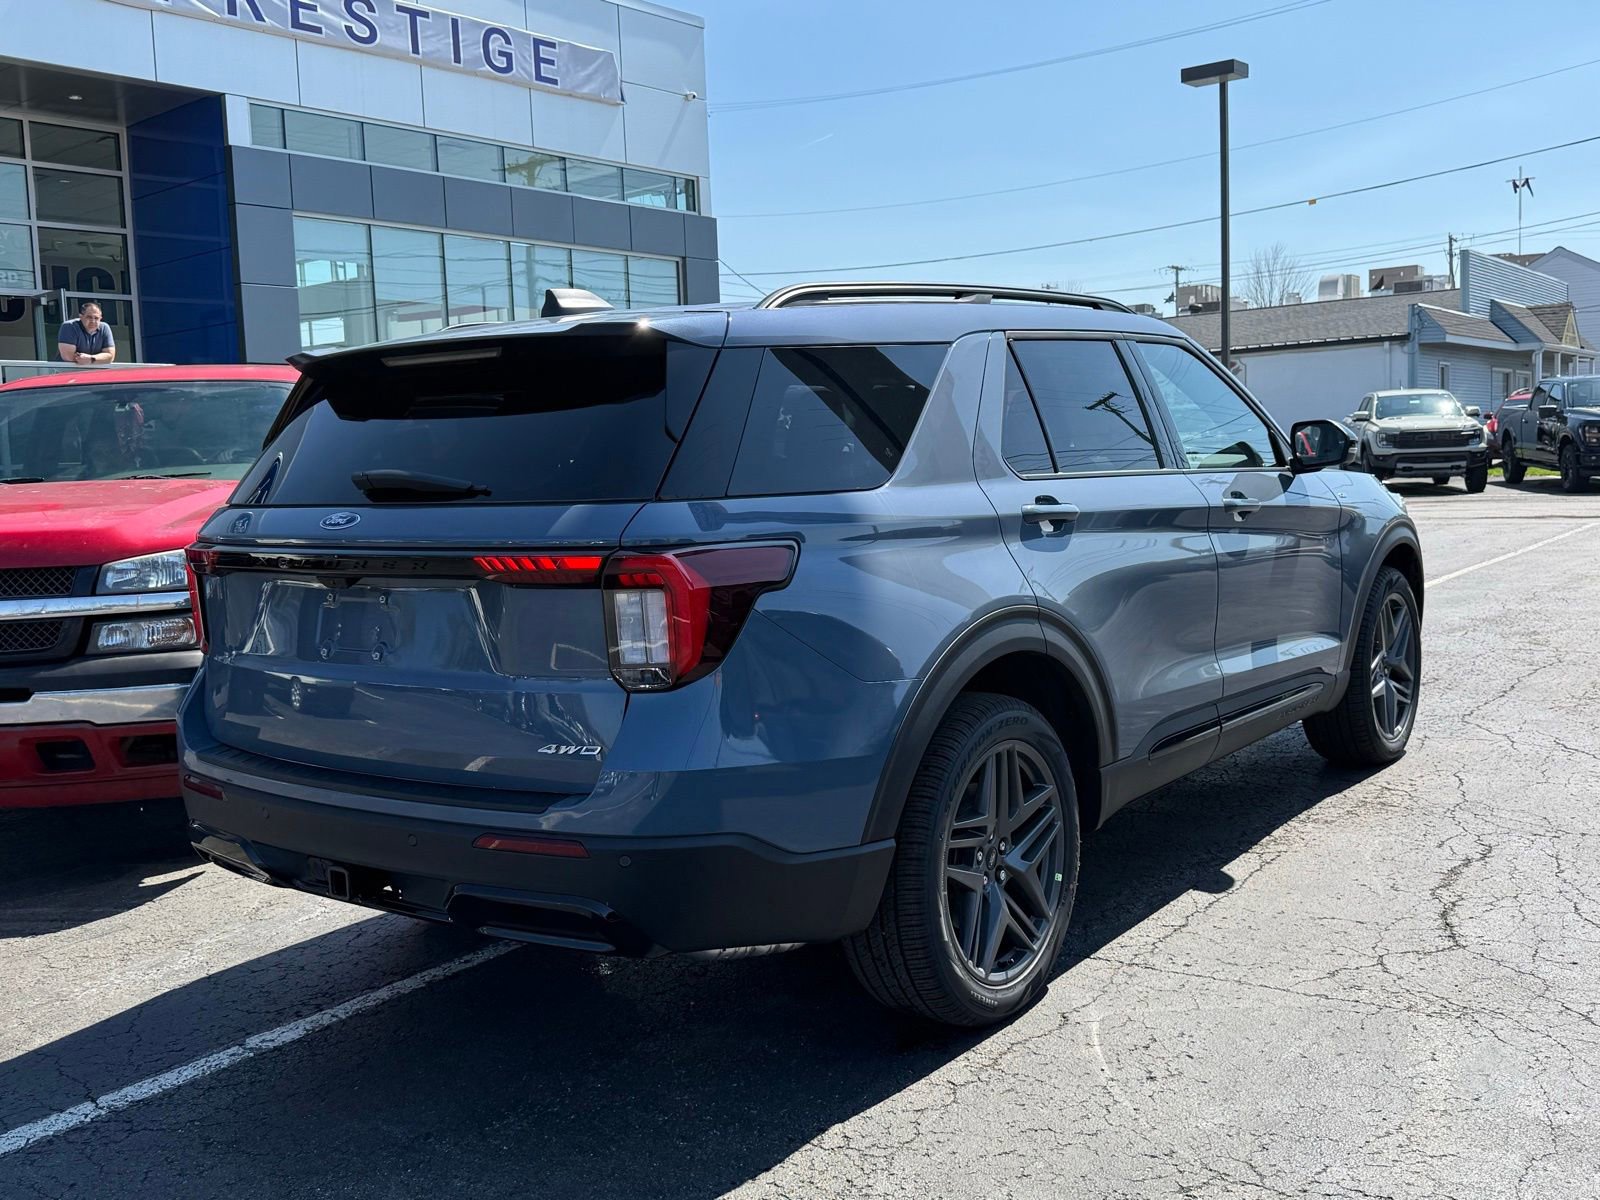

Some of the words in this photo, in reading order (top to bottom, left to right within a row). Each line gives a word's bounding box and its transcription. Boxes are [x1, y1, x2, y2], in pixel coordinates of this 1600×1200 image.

[164, 0, 560, 88] ESTIGE
[998, 716, 1029, 730] ZERO
[537, 743, 602, 756] 4WD
